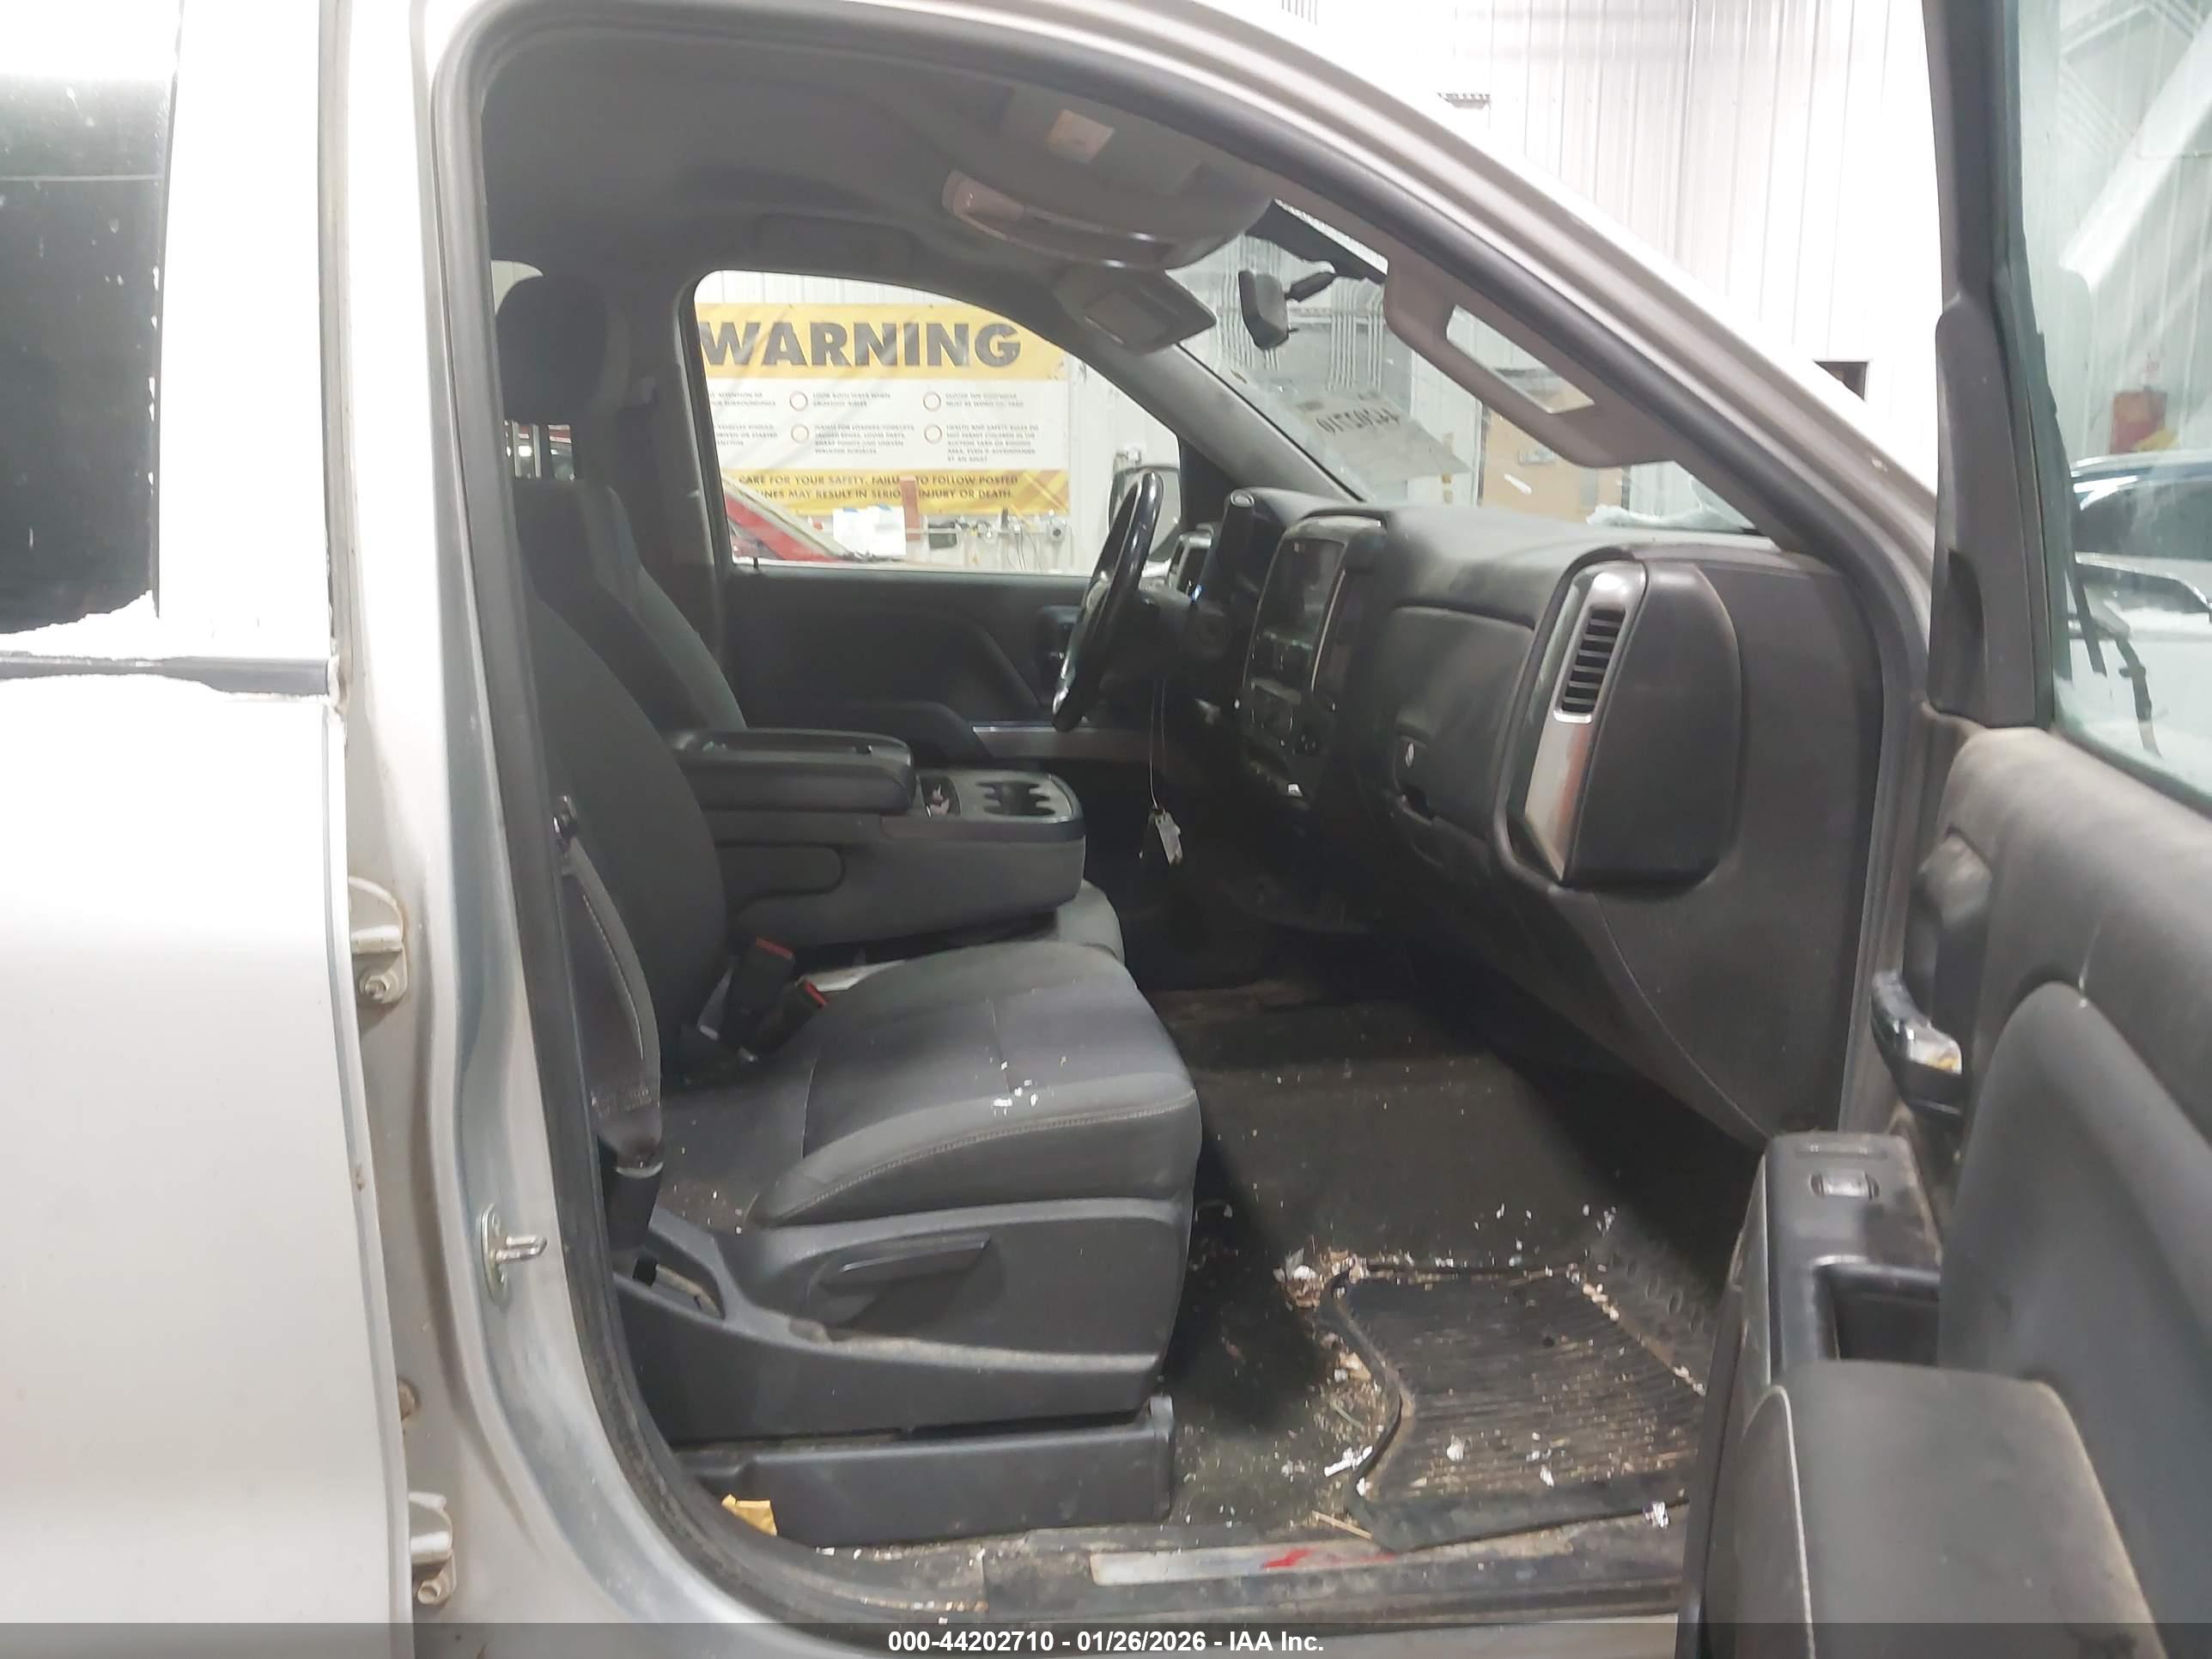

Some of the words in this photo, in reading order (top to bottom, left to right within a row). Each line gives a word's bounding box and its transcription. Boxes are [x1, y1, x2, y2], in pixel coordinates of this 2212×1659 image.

[700, 321, 1021, 368] WARNING
[738, 475, 764, 484] CARE
[769, 475, 790, 484] FOR
[794, 475, 824, 485] YOUR
[872, 475, 900, 485] FAILU
[915, 475, 928, 485] TO
[933, 475, 975, 486] FOLLOW
[980, 476, 1018, 486] POSTED
[788, 489, 811, 498] MAY
[817, 489, 852, 498] RESULT
[856, 489, 867, 498] IN
[872, 489, 901, 499] SERIO
[919, 489, 955, 498] INJURY
